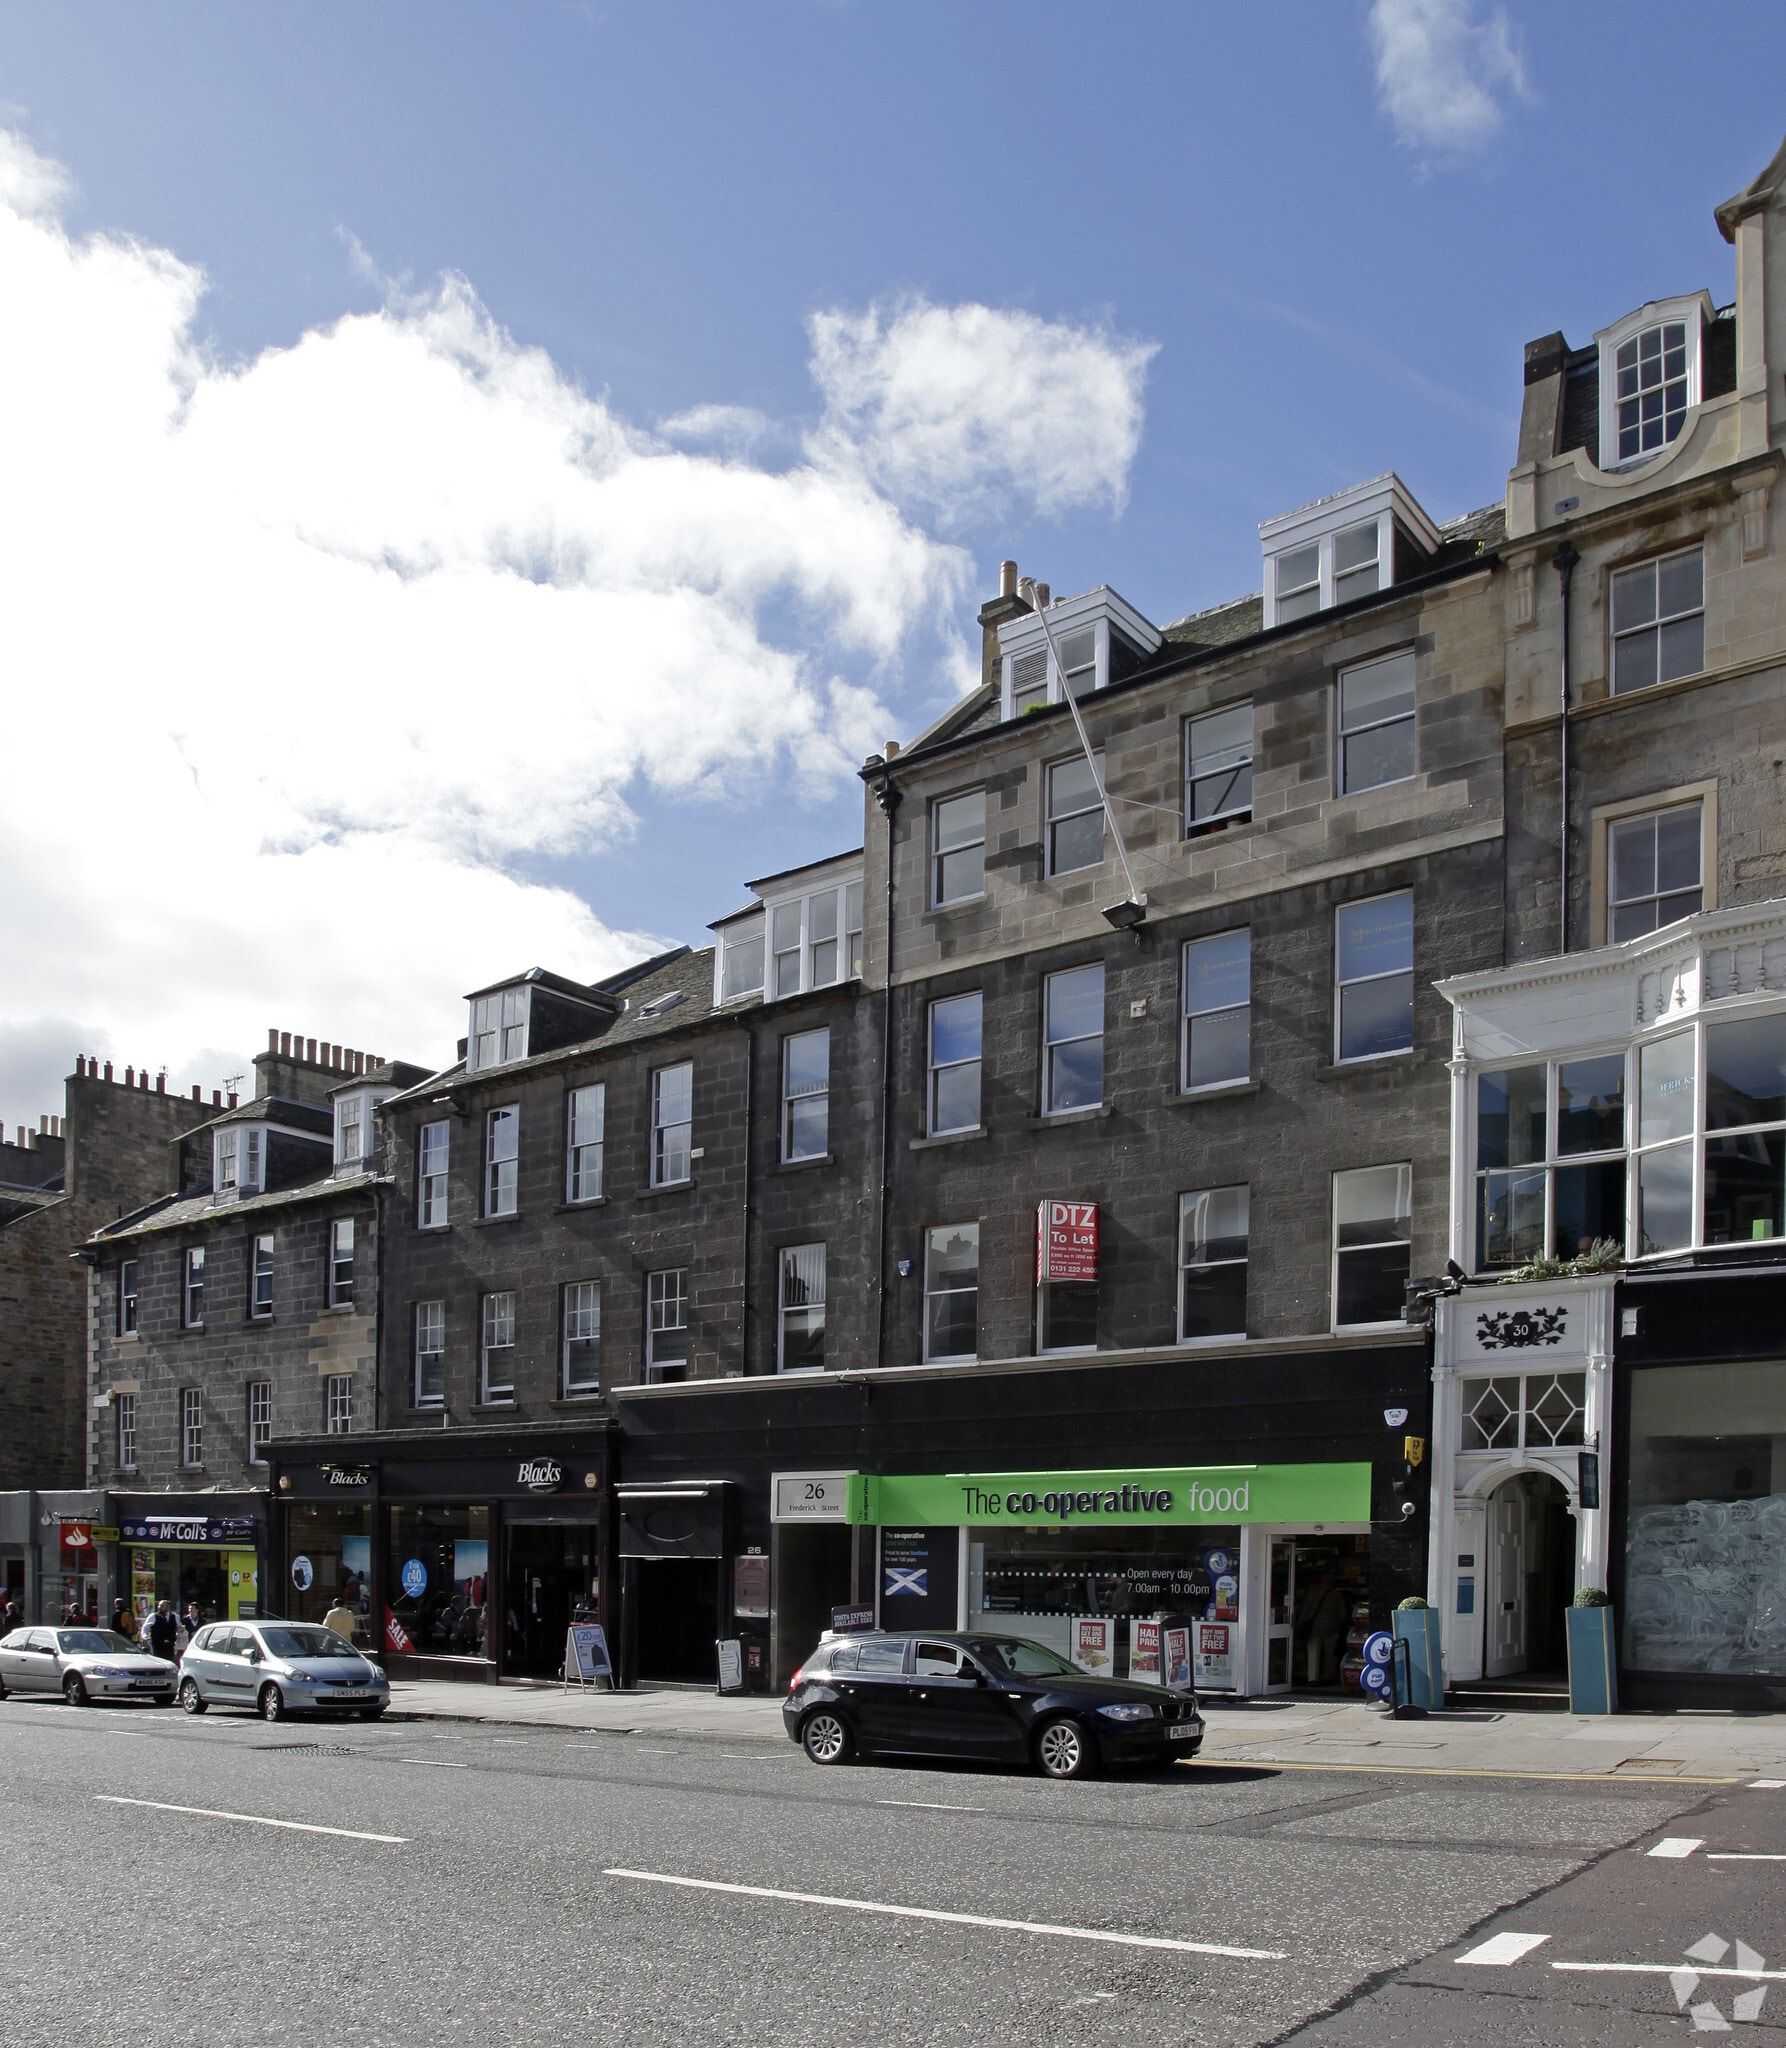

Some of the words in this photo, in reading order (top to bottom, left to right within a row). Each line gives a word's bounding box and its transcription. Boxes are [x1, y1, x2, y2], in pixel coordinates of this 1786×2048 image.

[1052, 1203, 1094, 1227] DTZ
[1051, 1231, 1067, 1242] To
[1073, 1233, 1094, 1244] Let
[1513, 1324, 1528, 1336] 30
[330, 1472, 368, 1484] Blacks
[517, 1462, 562, 1482] Blacks
[804, 1483, 825, 1500] 26
[962, 1487, 1000, 1515] The
[1006, 1484, 1173, 1519] co-operative
[1189, 1480, 1250, 1512] food
[160, 1523, 207, 1540] McColl's
[407, 1569, 422, 1583] £40
[1127, 1568, 1149, 1580] Open
[1152, 1570, 1175, 1580] every
[1177, 1569, 1193, 1580] day
[1127, 1583, 1160, 1593] 7.00am
[1170, 1584, 1210, 1596] 10.00pm
[388, 1618, 408, 1648] SALE
[578, 1631, 592, 1640] £20
[1140, 1629, 1158, 1638] HAL
[1081, 1636, 1102, 1645] FREE
[1140, 1638, 1158, 1646] PRIC
[1170, 1638, 1183, 1648] HALF
[1202, 1640, 1224, 1649] FREE
[1173, 1726, 1188, 1737] PL05
